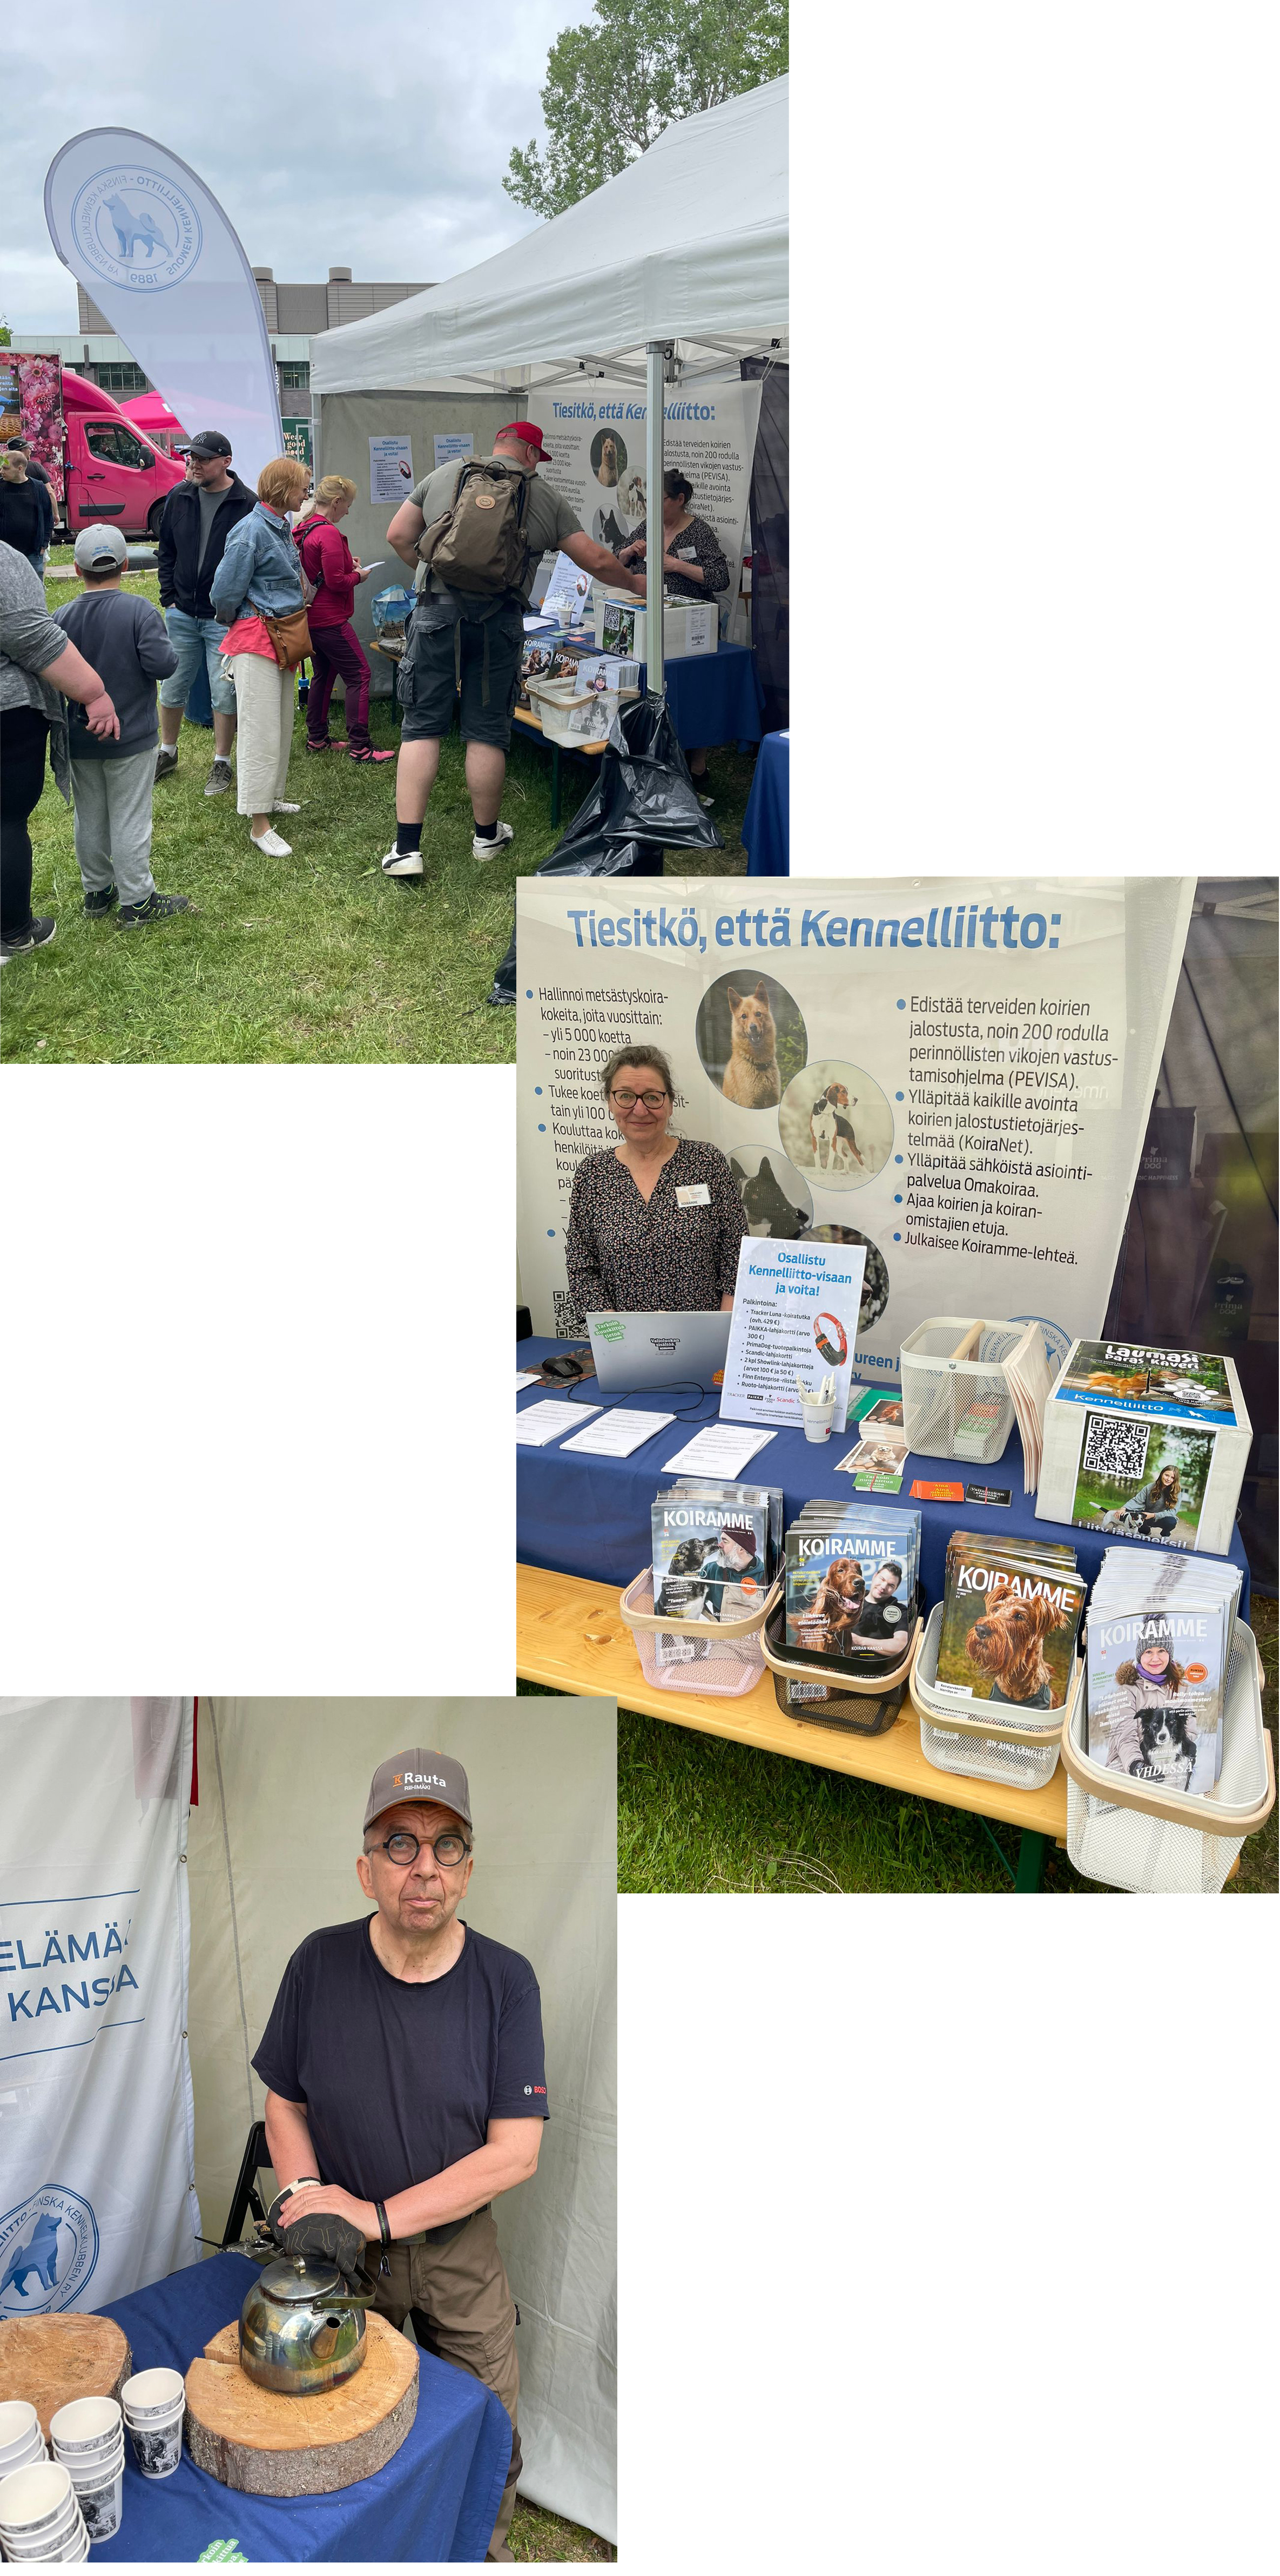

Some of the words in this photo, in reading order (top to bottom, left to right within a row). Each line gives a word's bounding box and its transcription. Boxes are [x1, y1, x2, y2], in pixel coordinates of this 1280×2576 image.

[553, 402, 596, 421] Tiesitkö,
[599, 402, 624, 420] että
[287, 440, 305, 449] good
[700, 462, 721, 470] vikojen
[702, 472, 730, 481] (PEVISA).
[709, 484, 731, 492] avointa
[716, 515, 738, 524] asiointi-
[567, 907, 707, 954] Tiesitkö,
[715, 907, 791, 947] että
[800, 905, 1062, 949] Kennelliitto:
[539, 987, 586, 1001] Hallinnoi
[587, 989, 668, 1005] metsästyskoira-
[911, 996, 963, 1014] Edistää
[967, 997, 1036, 1015] terveiden
[1040, 998, 1090, 1016] koirien
[541, 1007, 582, 1023] kokeita,
[583, 1008, 605, 1024] joita
[607, 1010, 663, 1025] vuosittain:
[551, 1028, 563, 1042] yli
[565, 1028, 571, 1041] 5
[575, 1028, 596, 1042] 000
[598, 1029, 632, 1044] koetta
[910, 1020, 983, 1041] jalostusta,
[987, 1024, 1018, 1040] noin
[1022, 1023, 1053, 1040] 200
[1056, 1024, 1108, 1042] rodulla
[553, 1048, 575, 1061] noin
[578, 1048, 591, 1062] 23
[910, 1045, 1005, 1063] perinnöllisten
[1009, 1047, 1060, 1067] vikojen
[1063, 1050, 1119, 1067] vastus-
[555, 1068, 601, 1081] suoritust
[909, 1067, 1004, 1087] tamisohjelma
[1009, 1070, 1079, 1091] (PEVISA).
[548, 1085, 578, 1099] Tukee
[908, 1089, 970, 1107] Ylläpitää
[973, 1091, 1022, 1109] kaikille
[1025, 1096, 1079, 1112] avointa
[550, 1104, 570, 1117] tain
[574, 1105, 583, 1120] yli
[587, 1106, 605, 1120] 100
[553, 1122, 603, 1139] Kouluttaa
[908, 1110, 952, 1127] koirien
[954, 1113, 1084, 1135] jalostustietojärjes-
[908, 1131, 955, 1149] telmää
[959, 1135, 1033, 1156] (KoiraNet).
[907, 1152, 966, 1170] Ylläpitää
[969, 1157, 1033, 1176] sähköistä
[1035, 1163, 1093, 1181] asiointi-
[907, 1174, 961, 1190] palvelua
[965, 1177, 1039, 1198] Omakoiraa.
[906, 1192, 934, 1209] Ajaa
[938, 1195, 979, 1213] koirien
[981, 1199, 993, 1216] ja
[996, 1201, 1042, 1218] koiran-
[906, 1214, 969, 1232] omistajien
[972, 1222, 1008, 1237] etuja.
[905, 1231, 959, 1250] Julkaisee
[962, 1238, 1078, 1265] Koiramme-lehteä.
[778, 1252, 826, 1266] Osallistu
[749, 1265, 852, 1284] Kennelliitto-visaan
[775, 1283, 785, 1294] ja
[789, 1285, 820, 1296] voita!
[743, 1298, 777, 1307] Palkintoina:
[595, 1325, 625, 1335] nuuskittua
[596, 1320, 618, 1329] Tarkoin
[749, 1325, 796, 1335] PAIKKA-lahjakortti
[745, 1350, 792, 1359] Scandic-lahjakortti
[746, 1341, 812, 1353] PrimaDog-tuotepalkintoja
[757, 1359, 814, 1370] Showlink-lahjakortteja
[742, 1382, 785, 1393] Ruoto-lahjakortti
[1074, 1393, 1164, 1412] Kennelliitto
[664, 1510, 754, 1530] KOIRAMME
[799, 1539, 896, 1557] KOIRAMME
[958, 1565, 1076, 1613] KOIRAMME
[1100, 1619, 1207, 1648] KOIRAMME
[1095, 1704, 1119, 1715] asukkaita
[1099, 1700, 1116, 1708] eläimet
[1136, 1758, 1193, 1778] YHDESSÄ
[405, 1772, 446, 1788] Rauta
[0, 1919, 131, 1972] ELÄMÄ
[32, 2196, 63, 2210] FINSKA
[65, 2205, 87, 2282] KENNELKLUBBEN
[60, 2283, 71, 2297] RY
